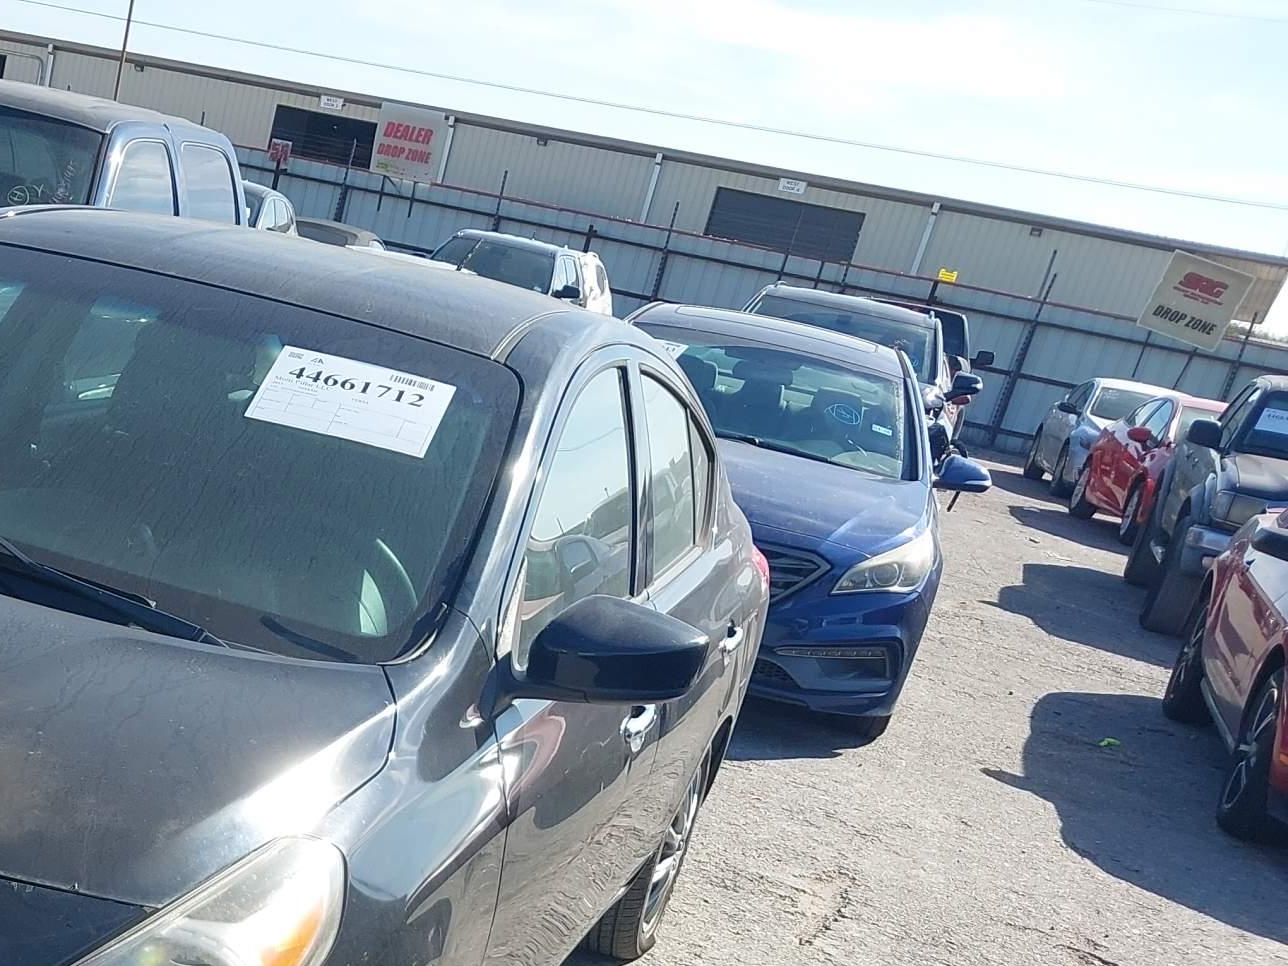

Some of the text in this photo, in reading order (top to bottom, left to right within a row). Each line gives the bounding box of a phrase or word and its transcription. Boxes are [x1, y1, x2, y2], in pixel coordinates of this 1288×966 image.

[383, 121, 434, 145] DEALER
[377, 142, 432, 164] DROP ZONE
[1152, 305, 1217, 335] DROP ZONE
[289, 366, 425, 408] 44661712
